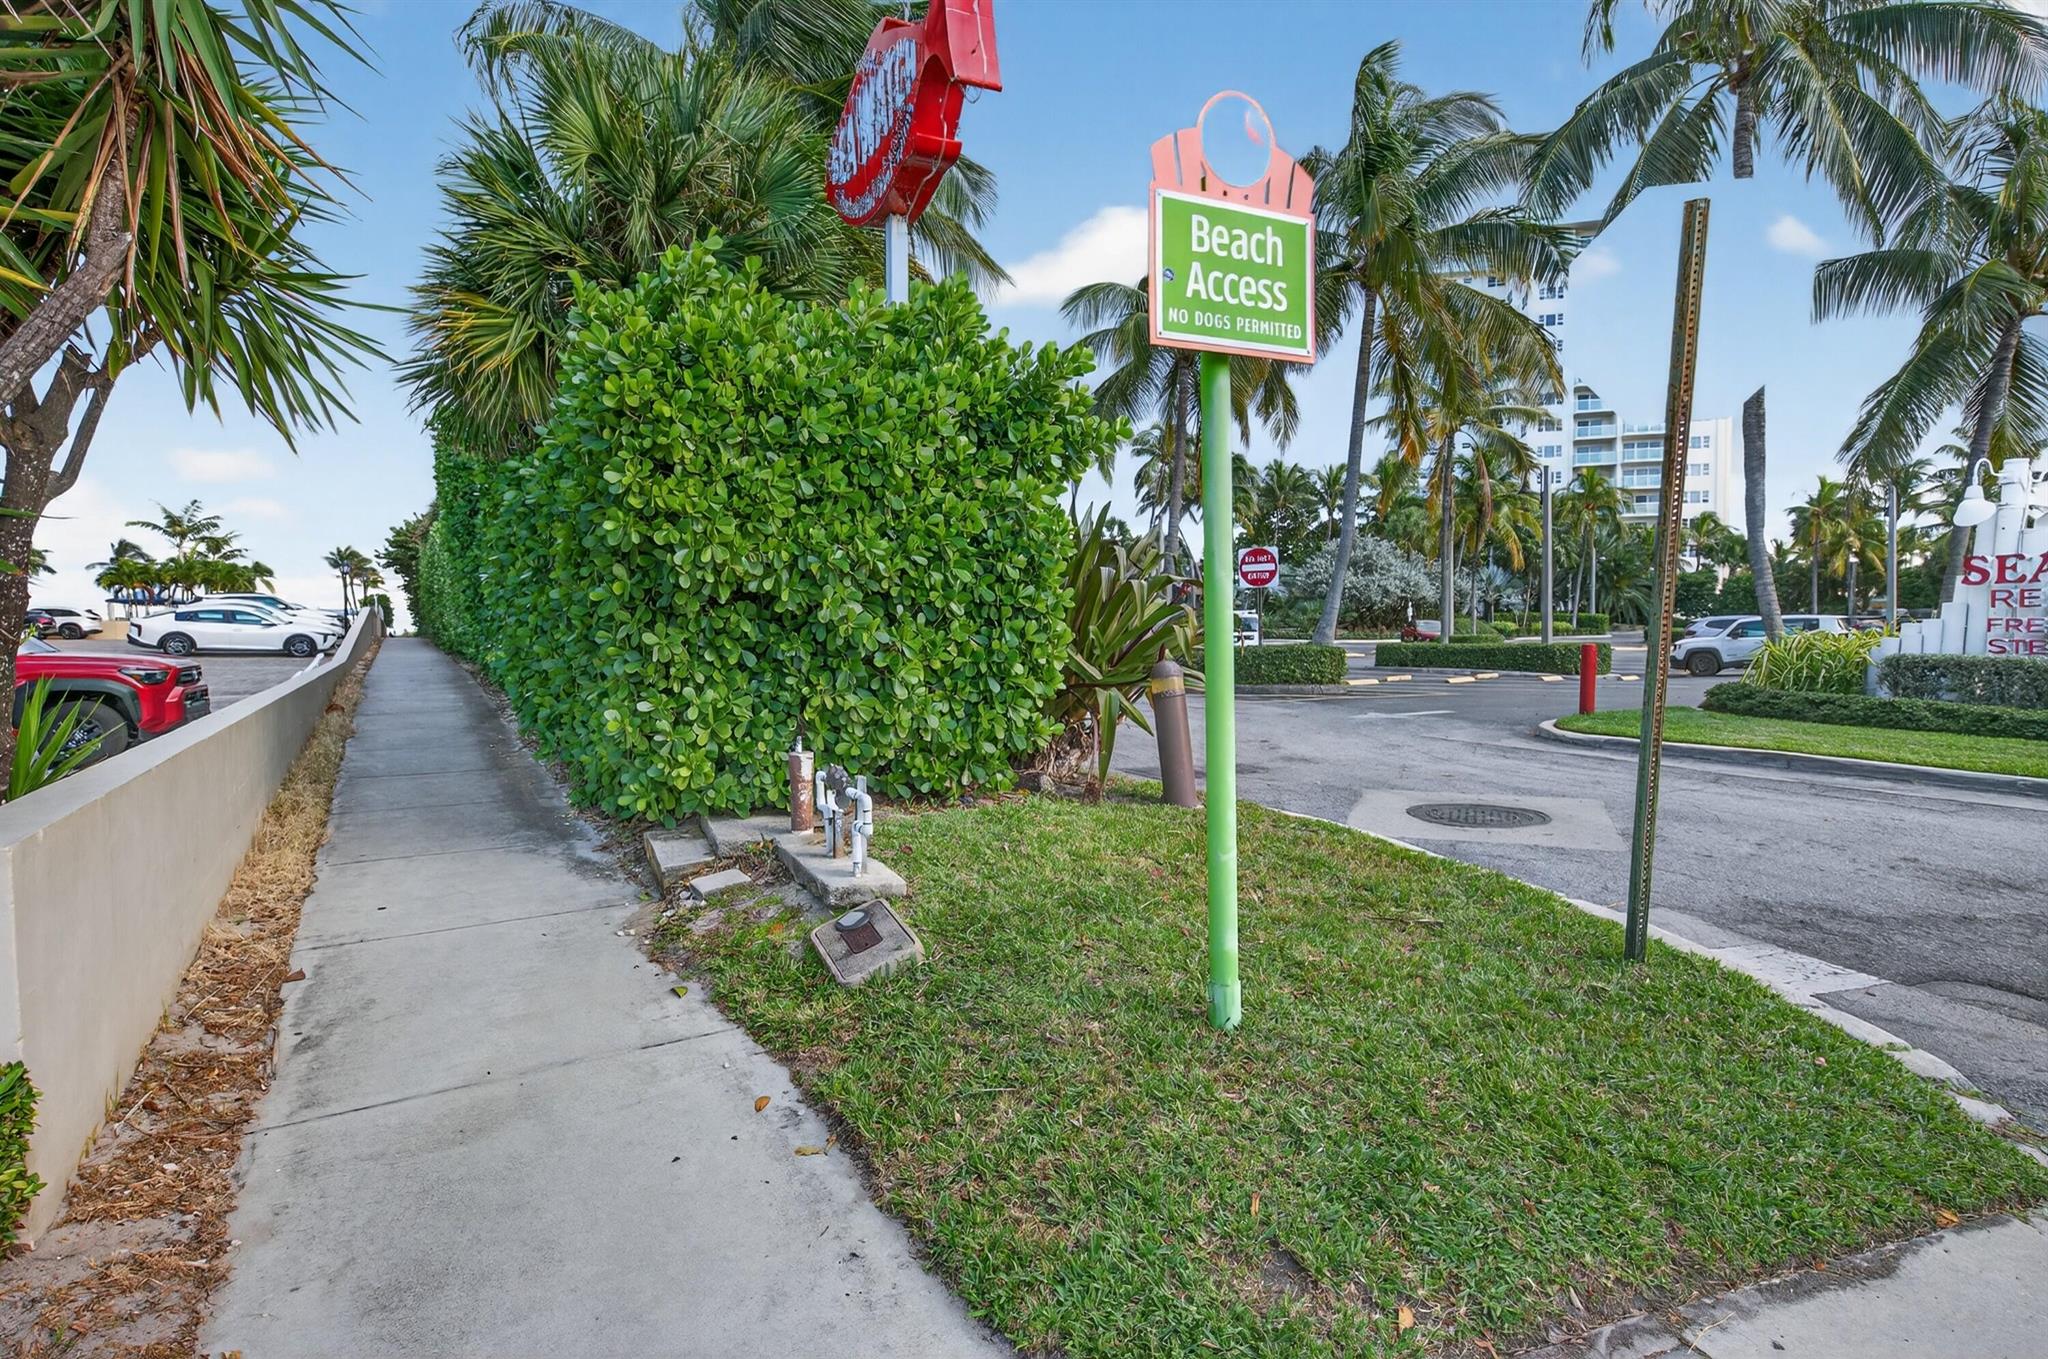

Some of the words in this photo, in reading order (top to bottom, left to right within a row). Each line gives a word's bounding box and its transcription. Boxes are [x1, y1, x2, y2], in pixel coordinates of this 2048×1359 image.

[1191, 214, 1283, 267] Beach
[1185, 261, 1288, 312] Access
[1168, 307, 1189, 325] NO
[1195, 311, 1231, 330] DOGS
[1236, 316, 1302, 340] PERMITTED
